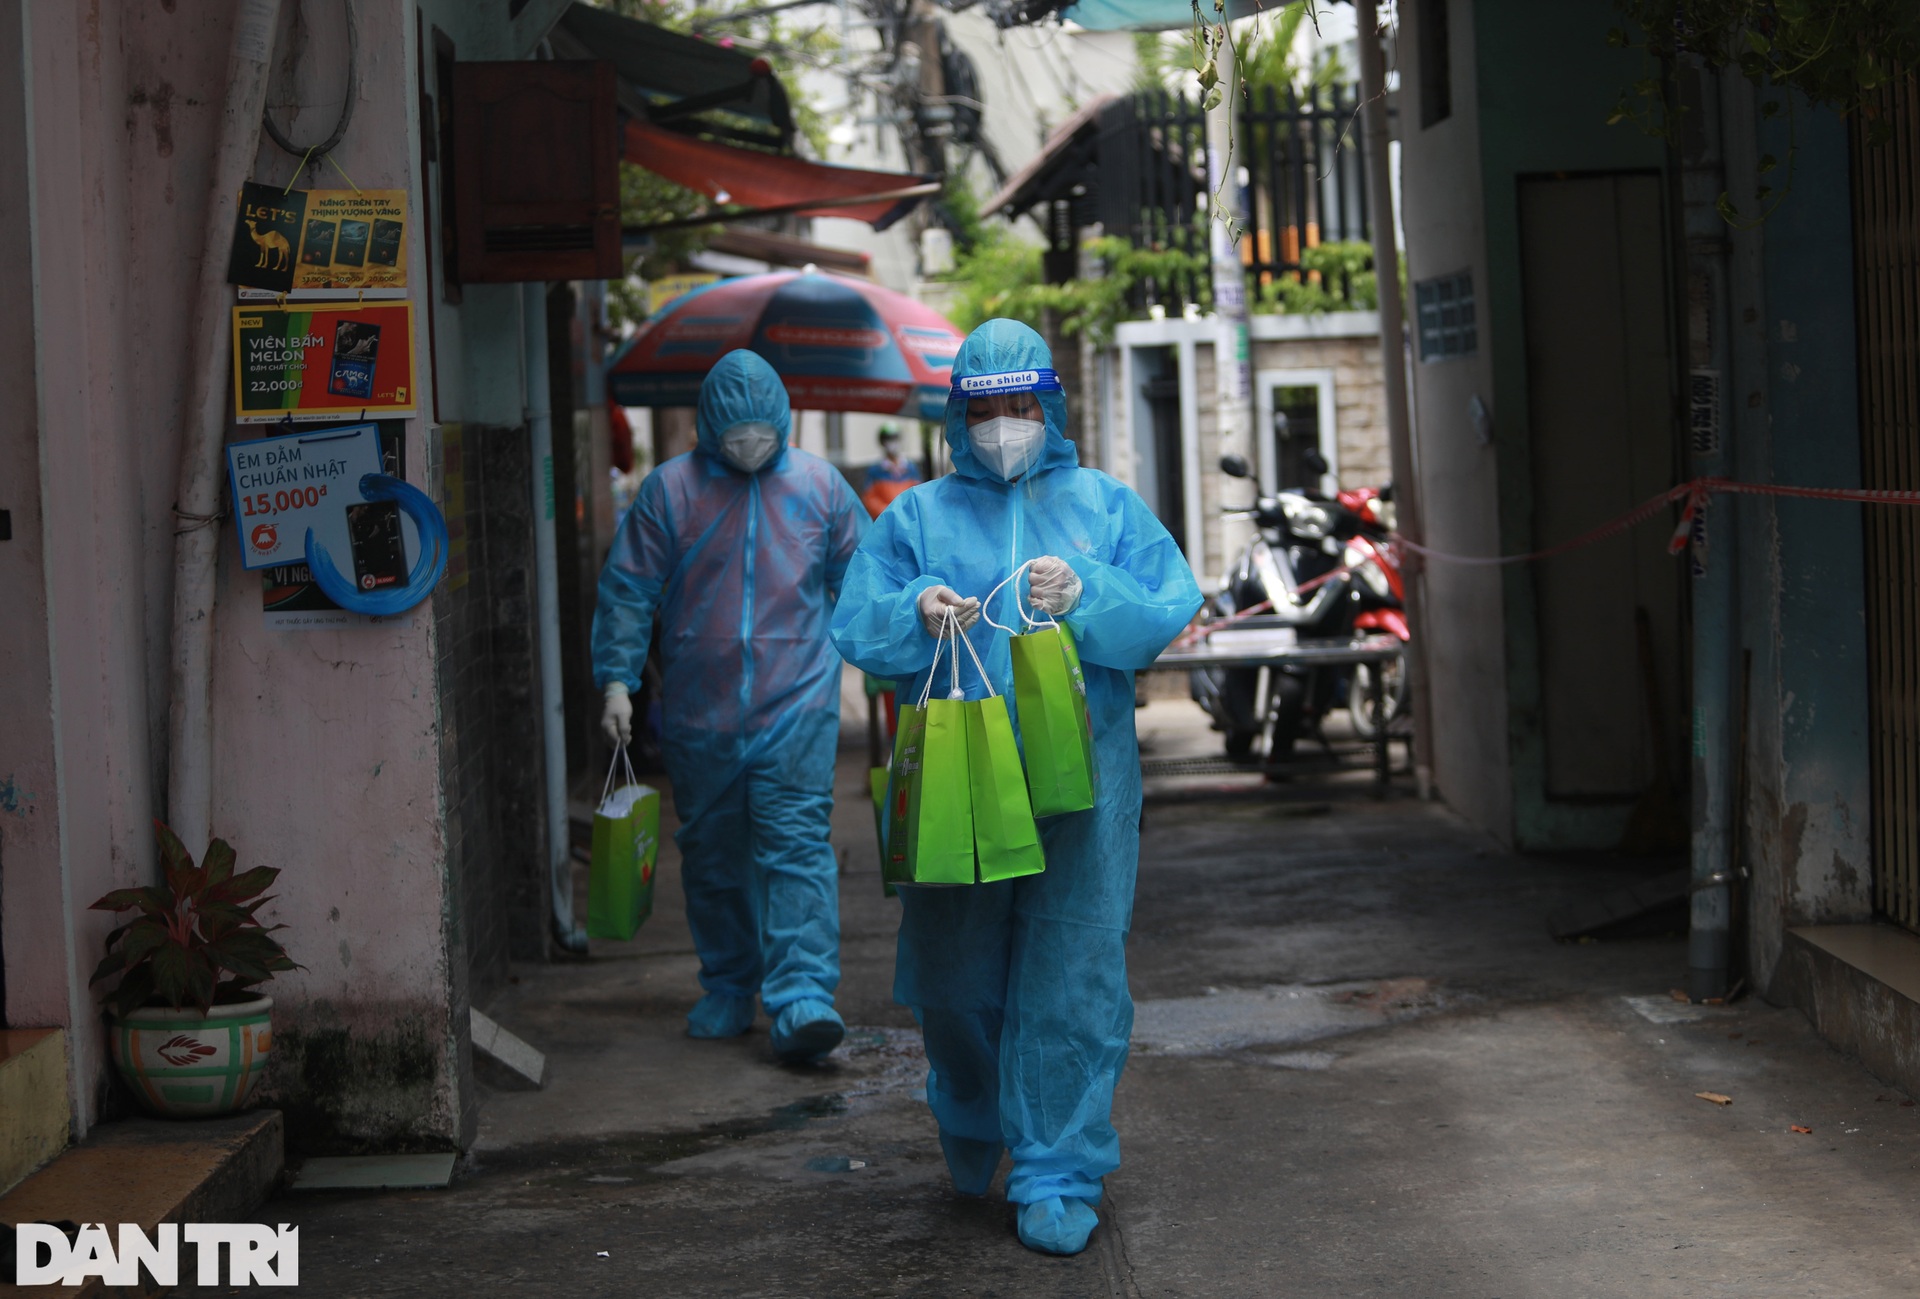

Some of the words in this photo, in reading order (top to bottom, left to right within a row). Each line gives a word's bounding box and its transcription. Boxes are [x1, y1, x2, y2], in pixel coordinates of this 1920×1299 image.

[245, 203, 298, 224] LET'S
[311, 209, 339, 217] THỊNH
[249, 335, 286, 349] VIÊN
[290, 333, 324, 348] BẤM
[250, 350, 305, 363] MELON
[335, 369, 369, 382] CAMEL
[966, 379, 992, 388] Face
[997, 373, 1032, 385] shield
[250, 380, 303, 393] 22,000đ
[969, 388, 985, 397] Direct
[985, 387, 1004, 396] Splash
[1004, 385, 1032, 395] protection
[237, 452, 260, 470] ÊM
[239, 465, 298, 489] CHUẨN
[303, 458, 347, 480] NHẬT
[243, 484, 327, 516] 15,000đ
[274, 567, 288, 585] VỊ
